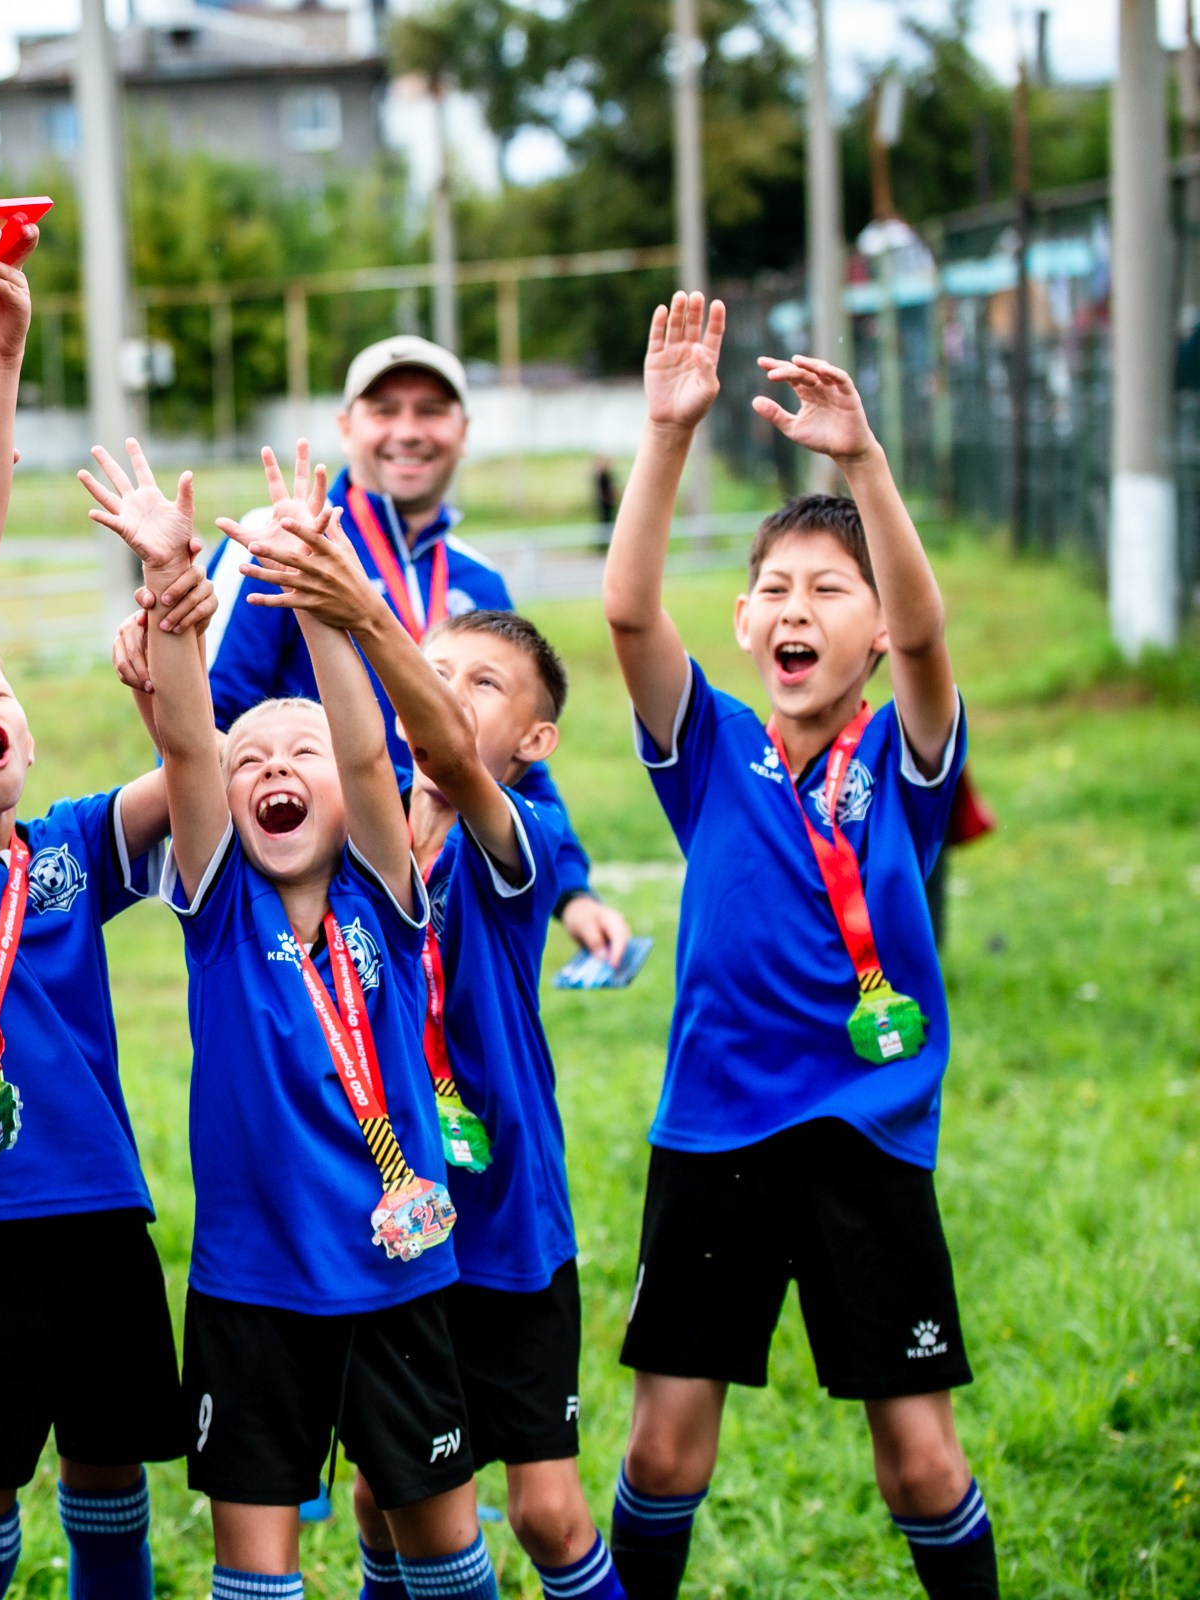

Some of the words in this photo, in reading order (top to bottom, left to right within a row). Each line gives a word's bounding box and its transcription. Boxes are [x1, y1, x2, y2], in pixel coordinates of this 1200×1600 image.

[349, 1079, 369, 1107] ООО
[411, 1204, 441, 1236] 2
[906, 1341, 948, 1359] KELME
[196, 1392, 213, 1453] 9
